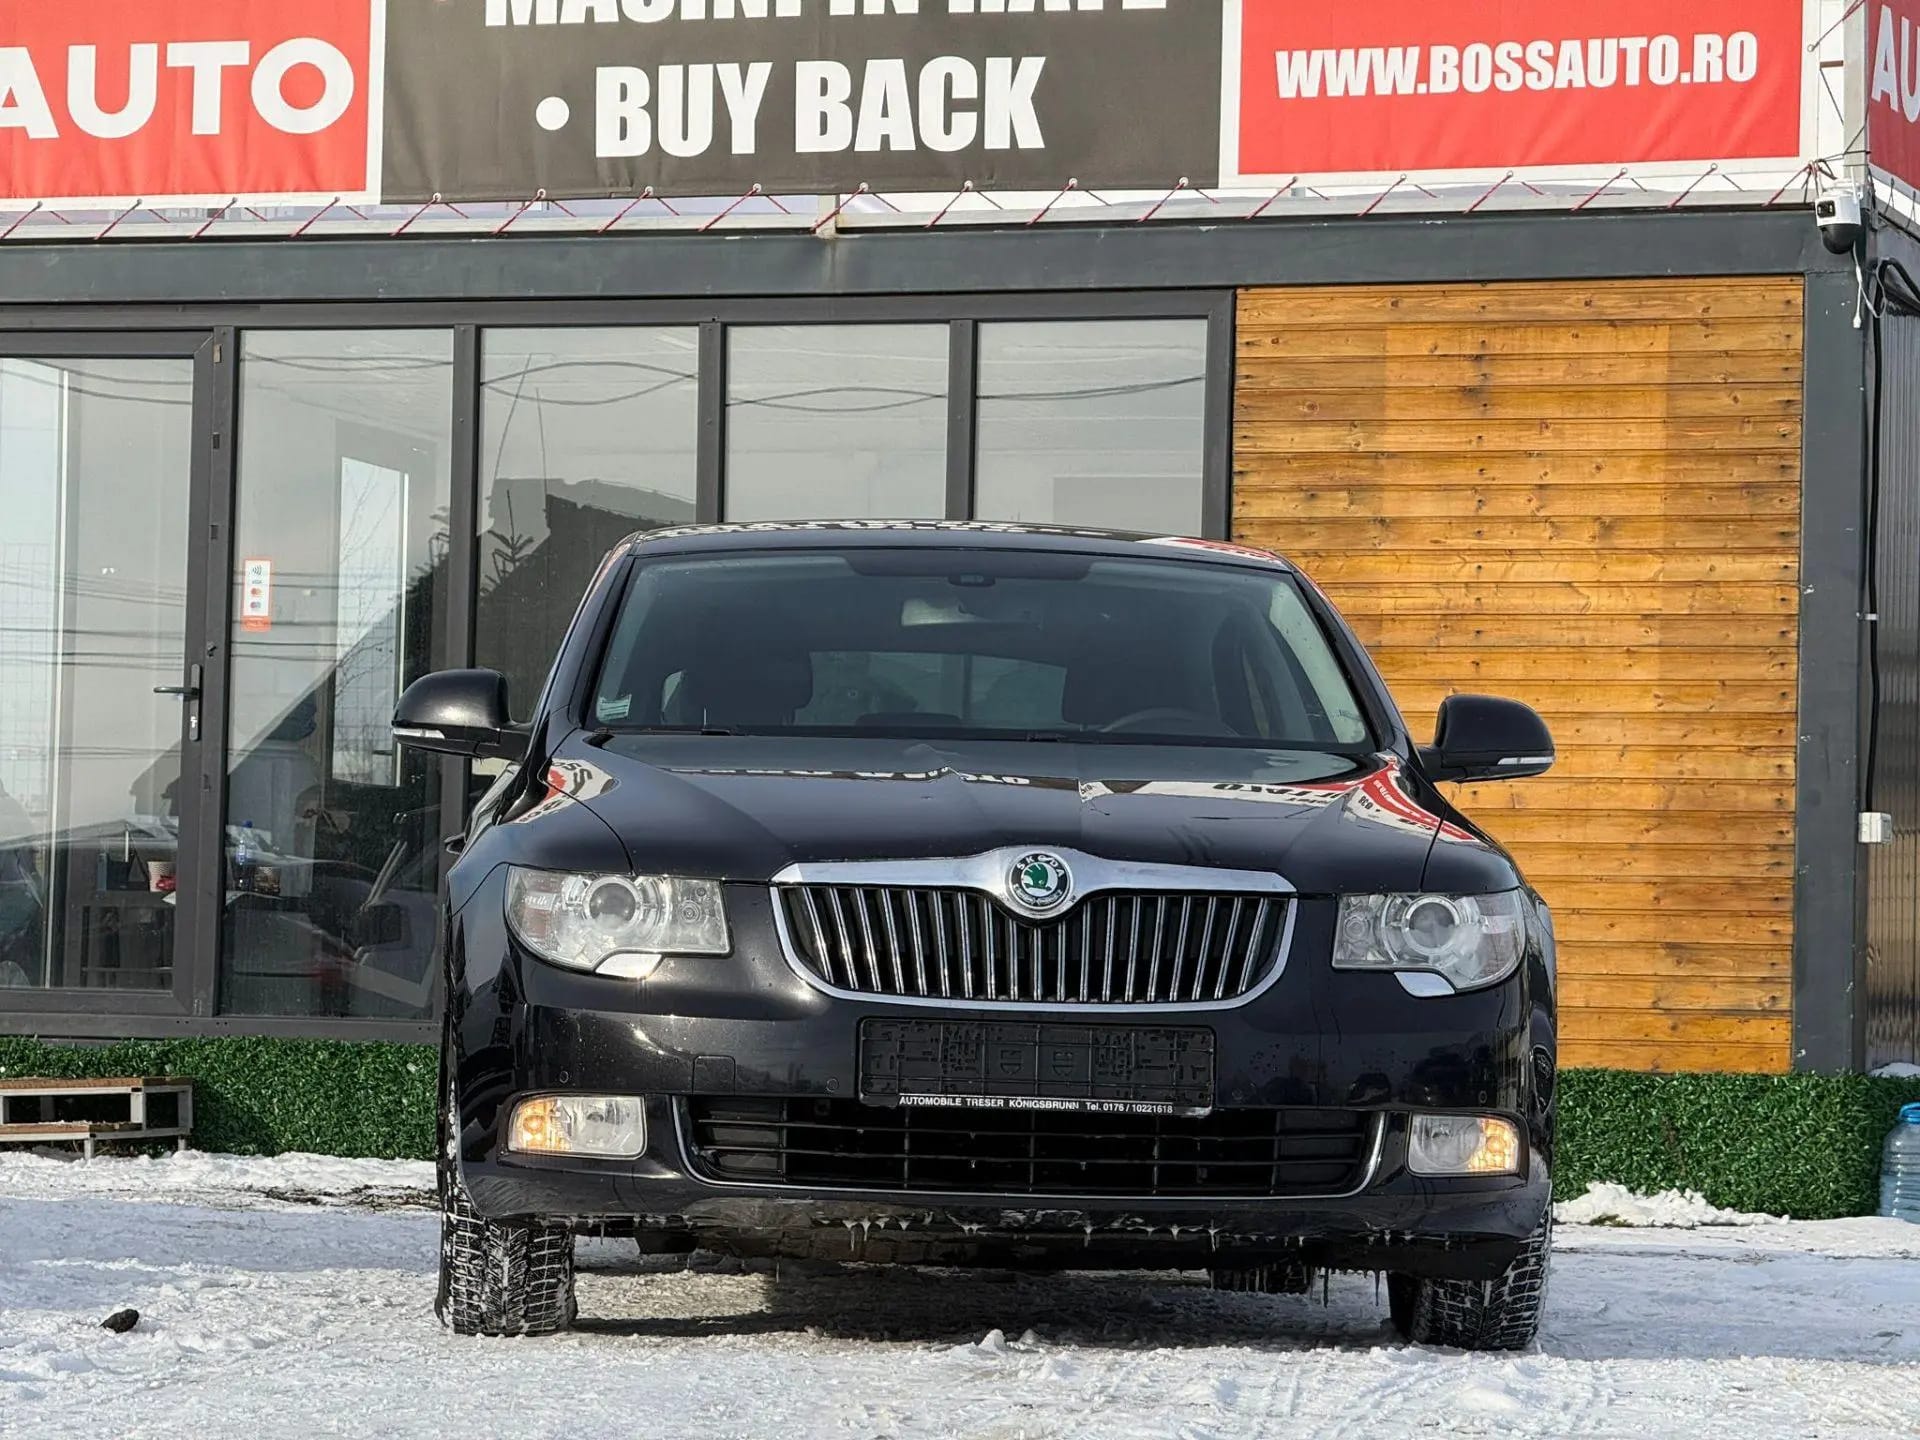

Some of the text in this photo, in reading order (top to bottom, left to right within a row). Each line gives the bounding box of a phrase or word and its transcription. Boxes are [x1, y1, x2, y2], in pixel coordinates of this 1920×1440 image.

[0, 37, 355, 140] AUTO
[595, 55, 1046, 158] BUY BACK
[1275, 31, 1758, 99] WWW.BOSSAUTO.RO
[898, 1096, 962, 1106] AUTOMOBILE
[965, 1097, 1004, 1108] TRESER
[1008, 1097, 1079, 1110] KÖNIGSBRUNN
[1085, 1102, 1101, 1111] Tel.
[1103, 1102, 1125, 1112] 0176
